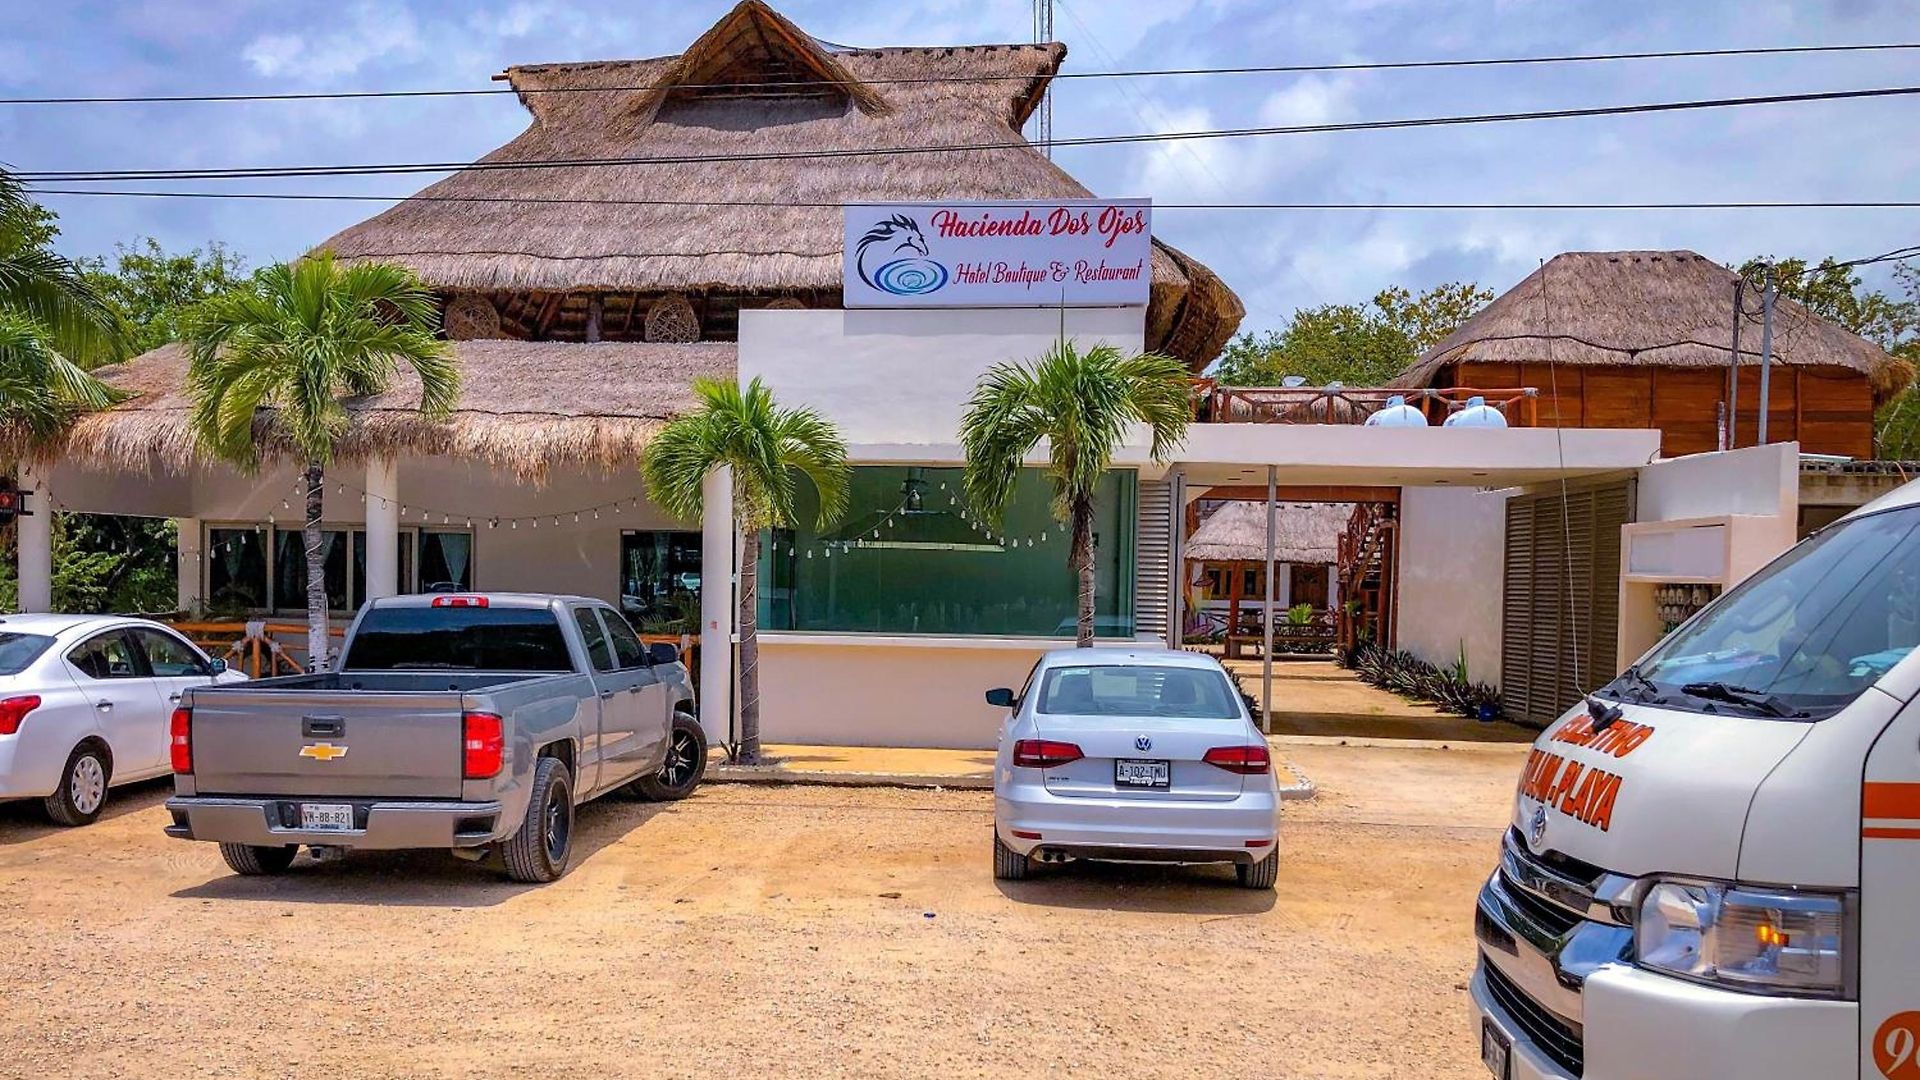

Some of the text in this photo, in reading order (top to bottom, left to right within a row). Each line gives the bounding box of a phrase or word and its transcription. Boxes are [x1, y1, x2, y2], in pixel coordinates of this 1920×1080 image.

[931, 206, 1147, 248] Hacienda Dos Ojos
[953, 258, 1143, 290] Hotel Boutique & Restaurant
[1886, 1027, 1920, 1075] 9
